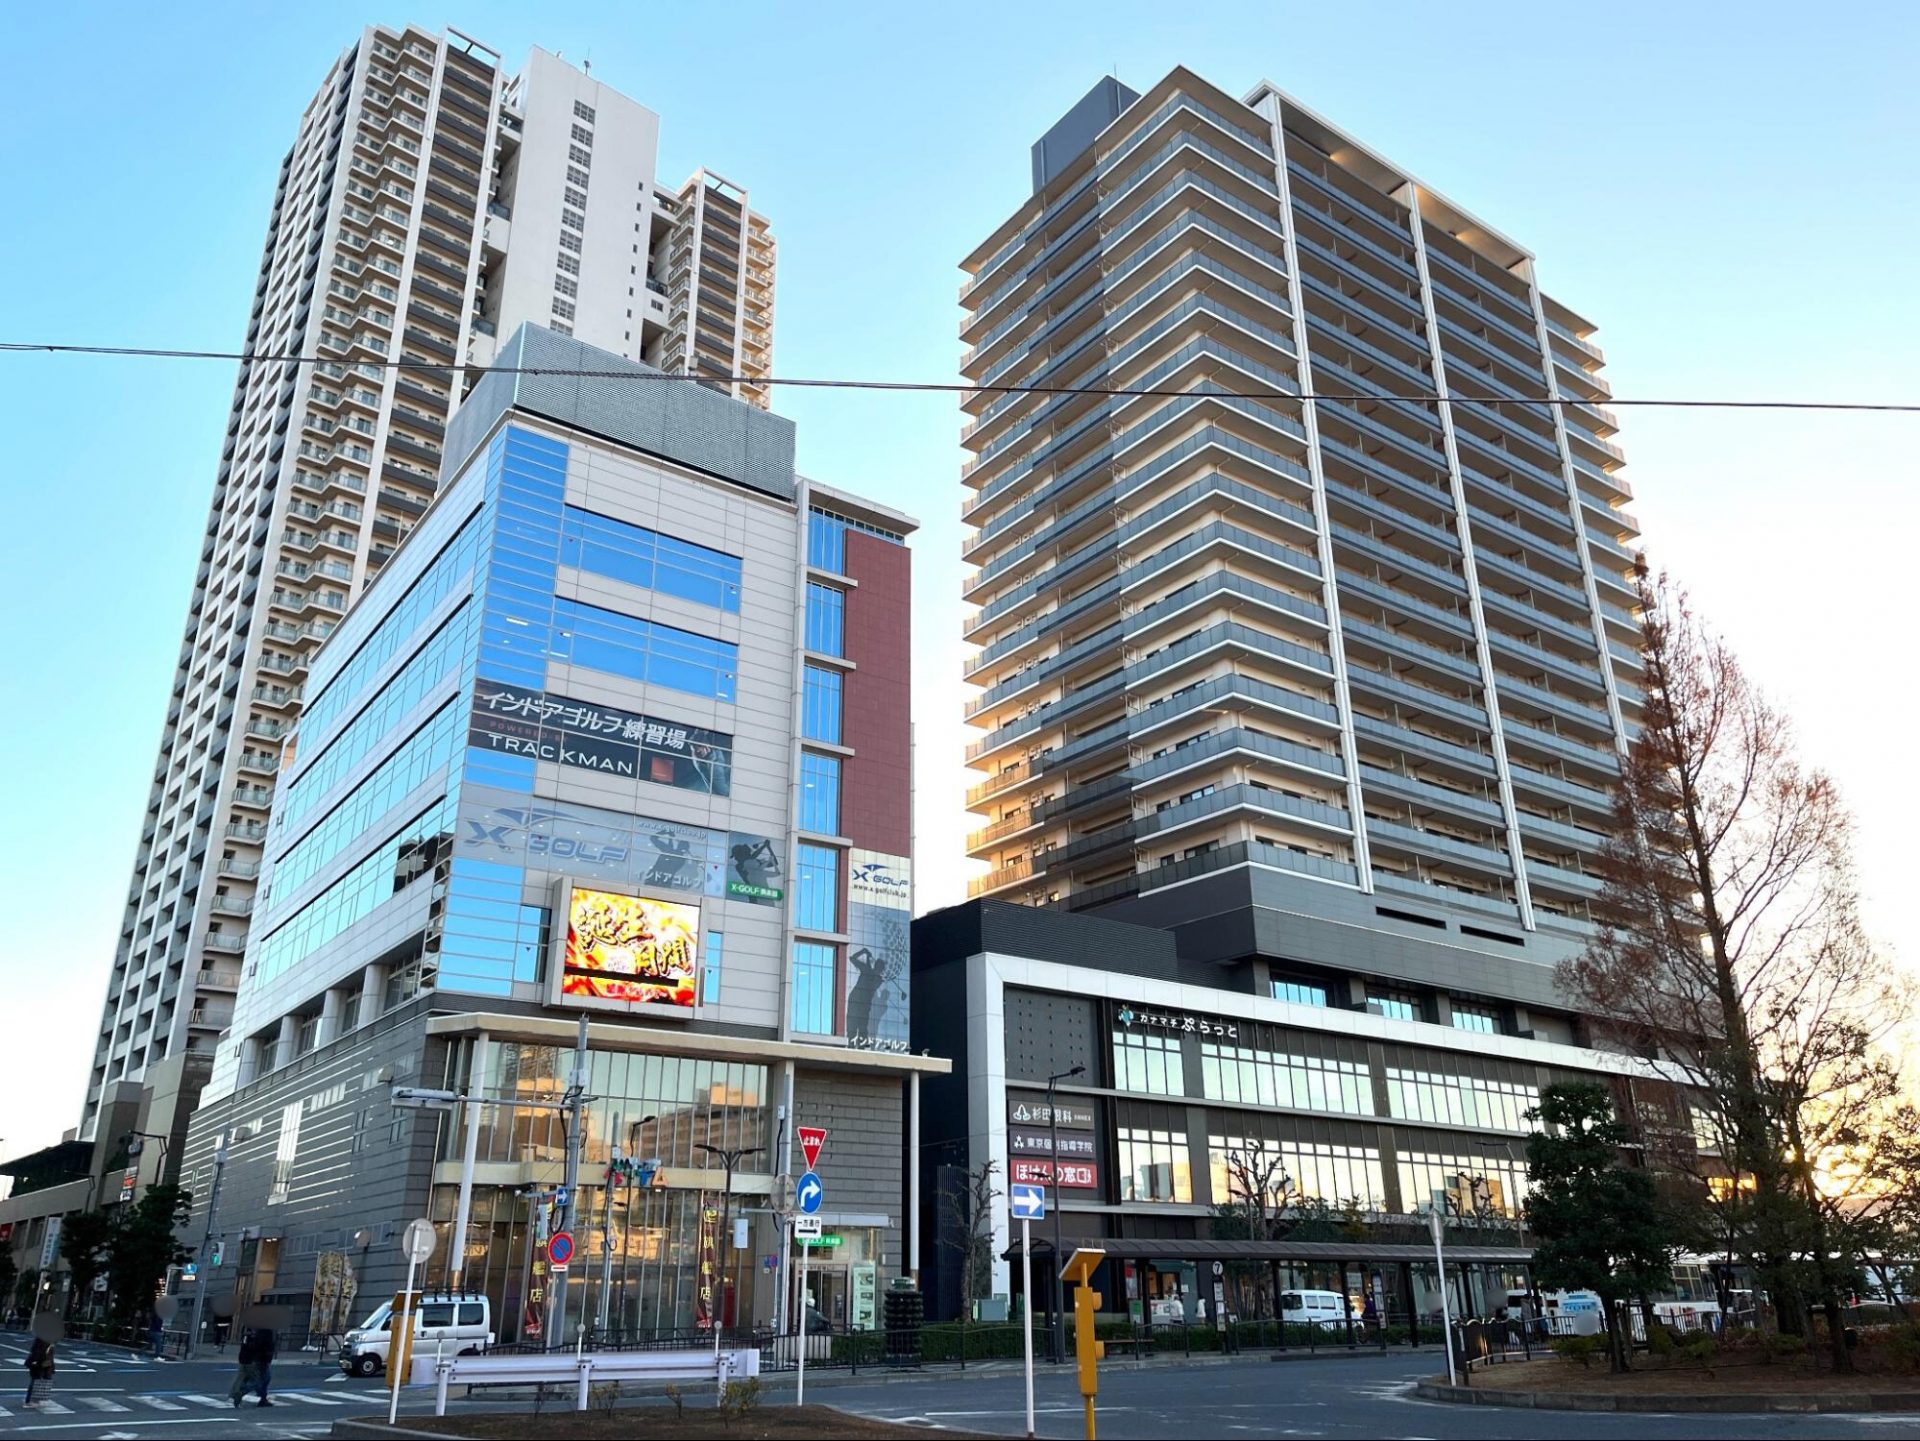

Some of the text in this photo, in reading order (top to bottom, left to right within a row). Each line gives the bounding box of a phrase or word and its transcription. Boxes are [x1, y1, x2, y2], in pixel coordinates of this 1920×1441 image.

[483, 692, 687, 750] インドアゴルフ練習場
[489, 721, 548, 739] POWERED
[488, 734, 634, 775] TRACKMAN
[465, 820, 629, 865] X GOLF
[853, 869, 909, 887] X GOLF
[850, 1035, 908, 1051] インドアゴルフ
[803, 1136, 820, 1146] 止まれ
[1214, 1264, 1222, 1273] 7
